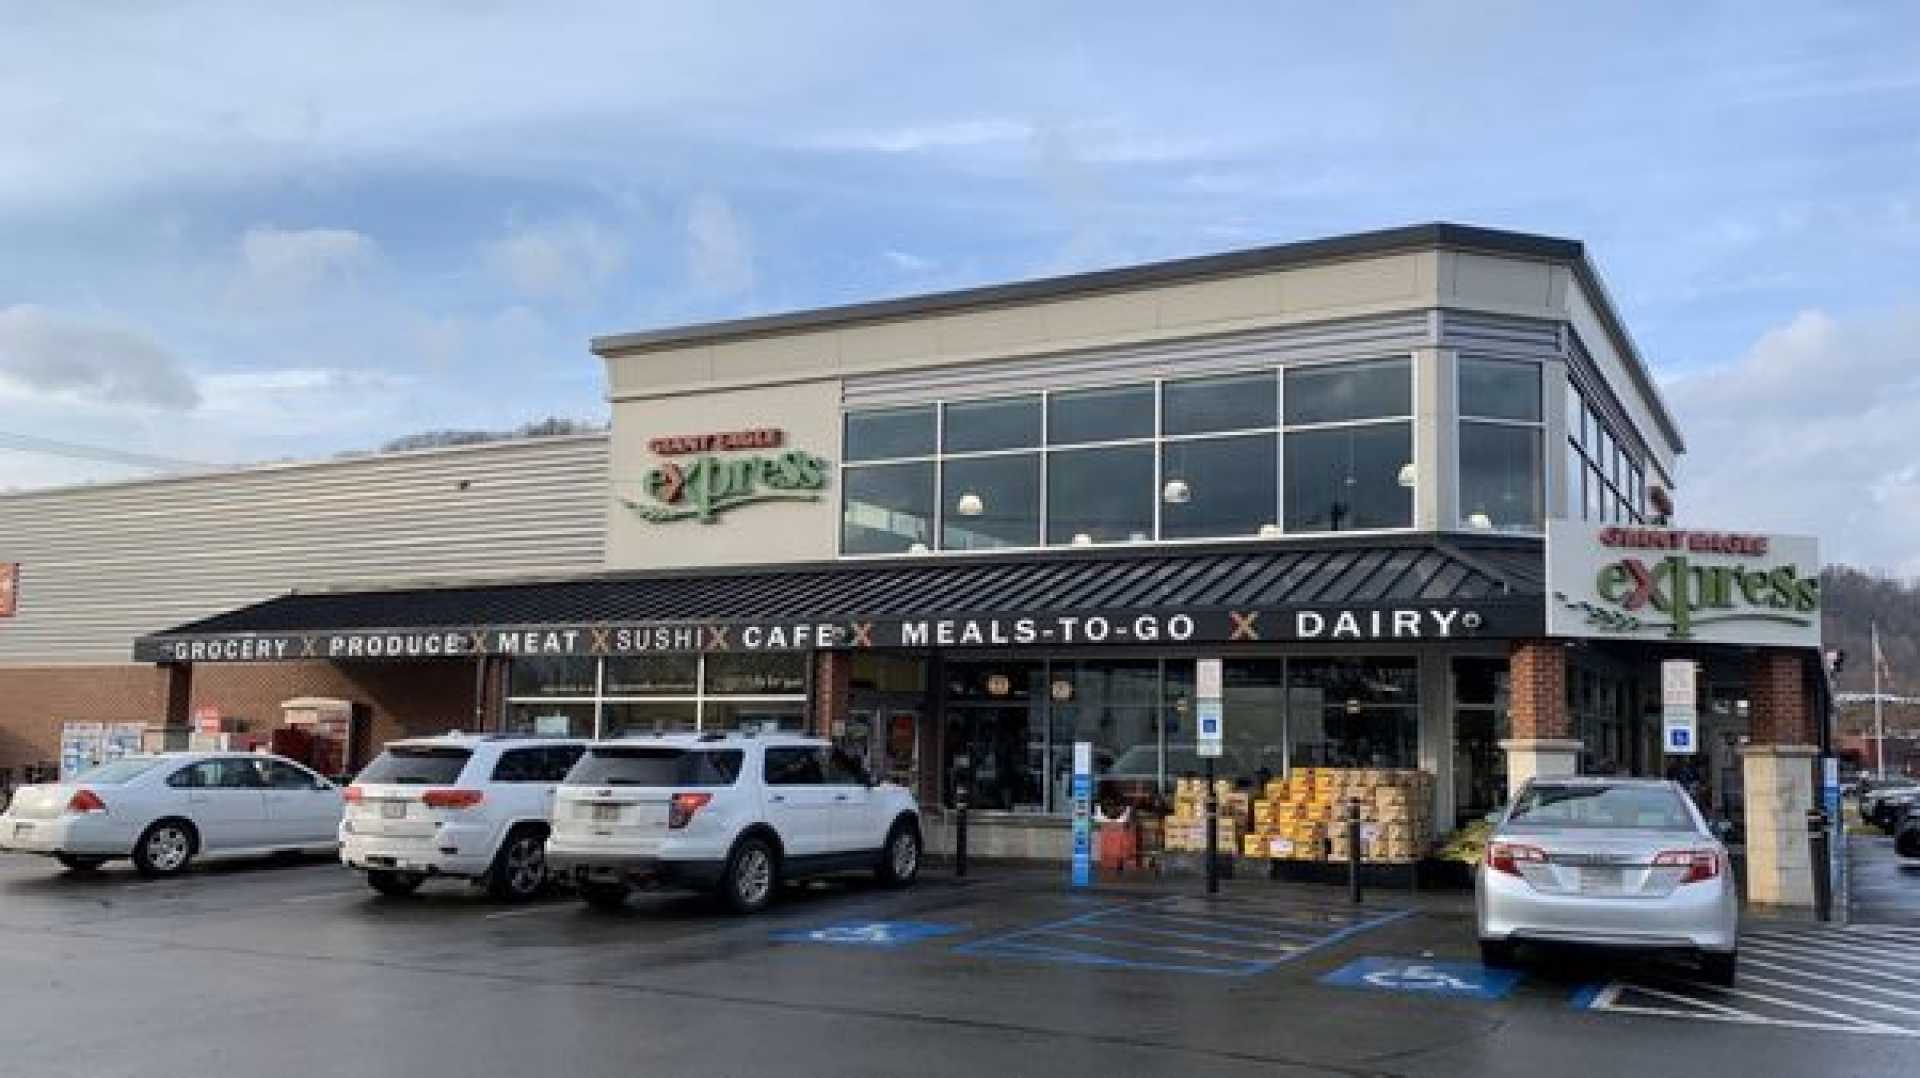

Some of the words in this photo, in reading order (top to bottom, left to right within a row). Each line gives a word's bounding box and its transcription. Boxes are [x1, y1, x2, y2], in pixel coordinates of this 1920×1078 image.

[643, 451, 831, 524] express
[1597, 557, 1817, 636] express
[175, 638, 288, 660] GROCERY
[329, 633, 460, 657] PRODUCE
[498, 630, 579, 654] MEAT
[616, 628, 702, 651] SUSHI
[742, 625, 833, 648] CAFE
[901, 614, 1194, 647] MEALS-TO-GO
[1296, 608, 1459, 638] DAIRY
